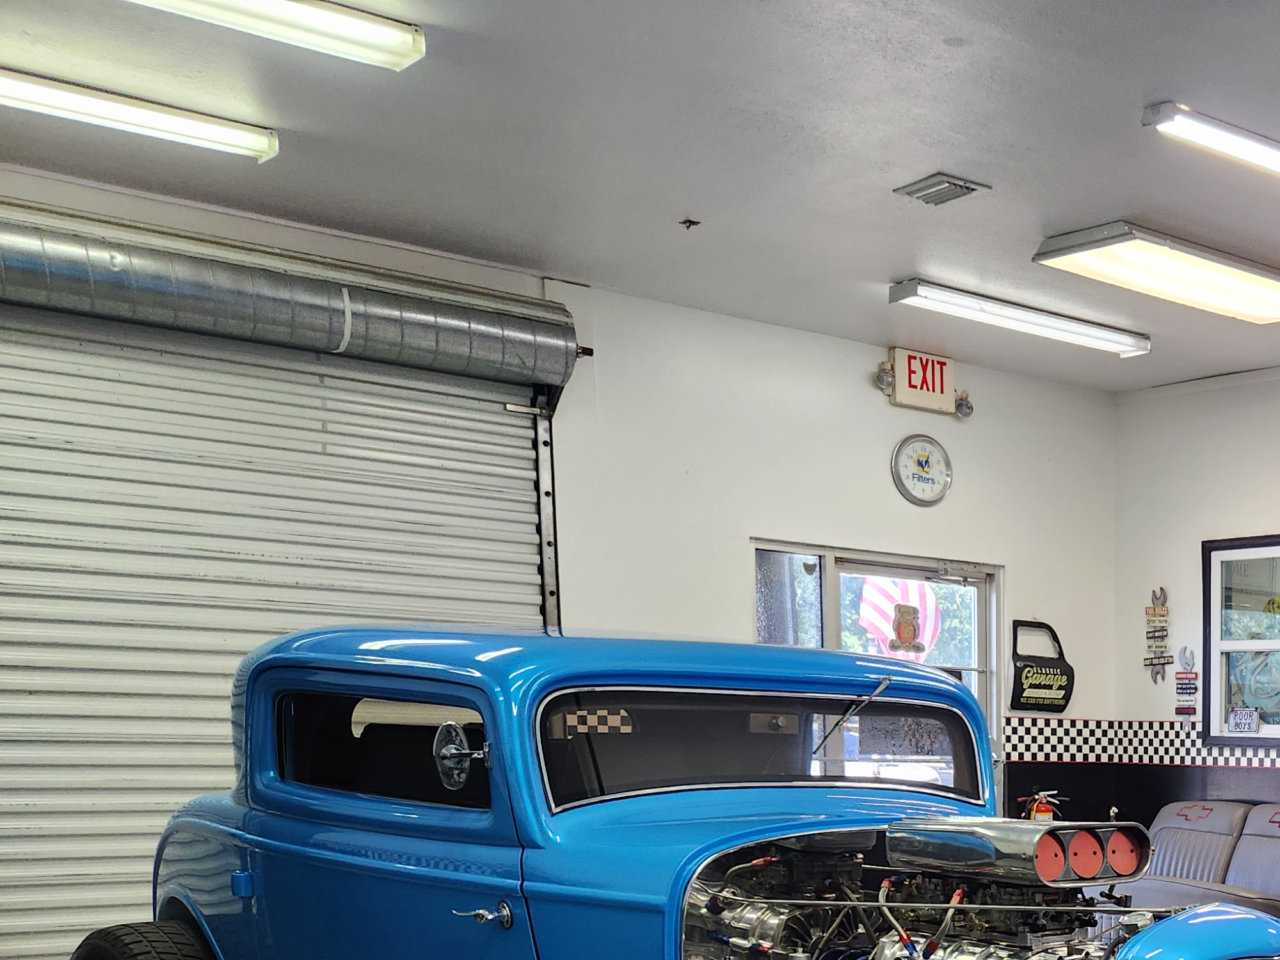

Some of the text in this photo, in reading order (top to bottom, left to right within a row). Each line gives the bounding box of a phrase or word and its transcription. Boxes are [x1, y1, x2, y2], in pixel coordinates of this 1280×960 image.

[907, 354, 947, 395] EXIT
[912, 472, 935, 485] Filters
[1034, 667, 1061, 675] CLASSIC
[1022, 667, 1068, 690] Garage
[1234, 712, 1253, 720] POOR
[1235, 722, 1251, 730] BOYS
